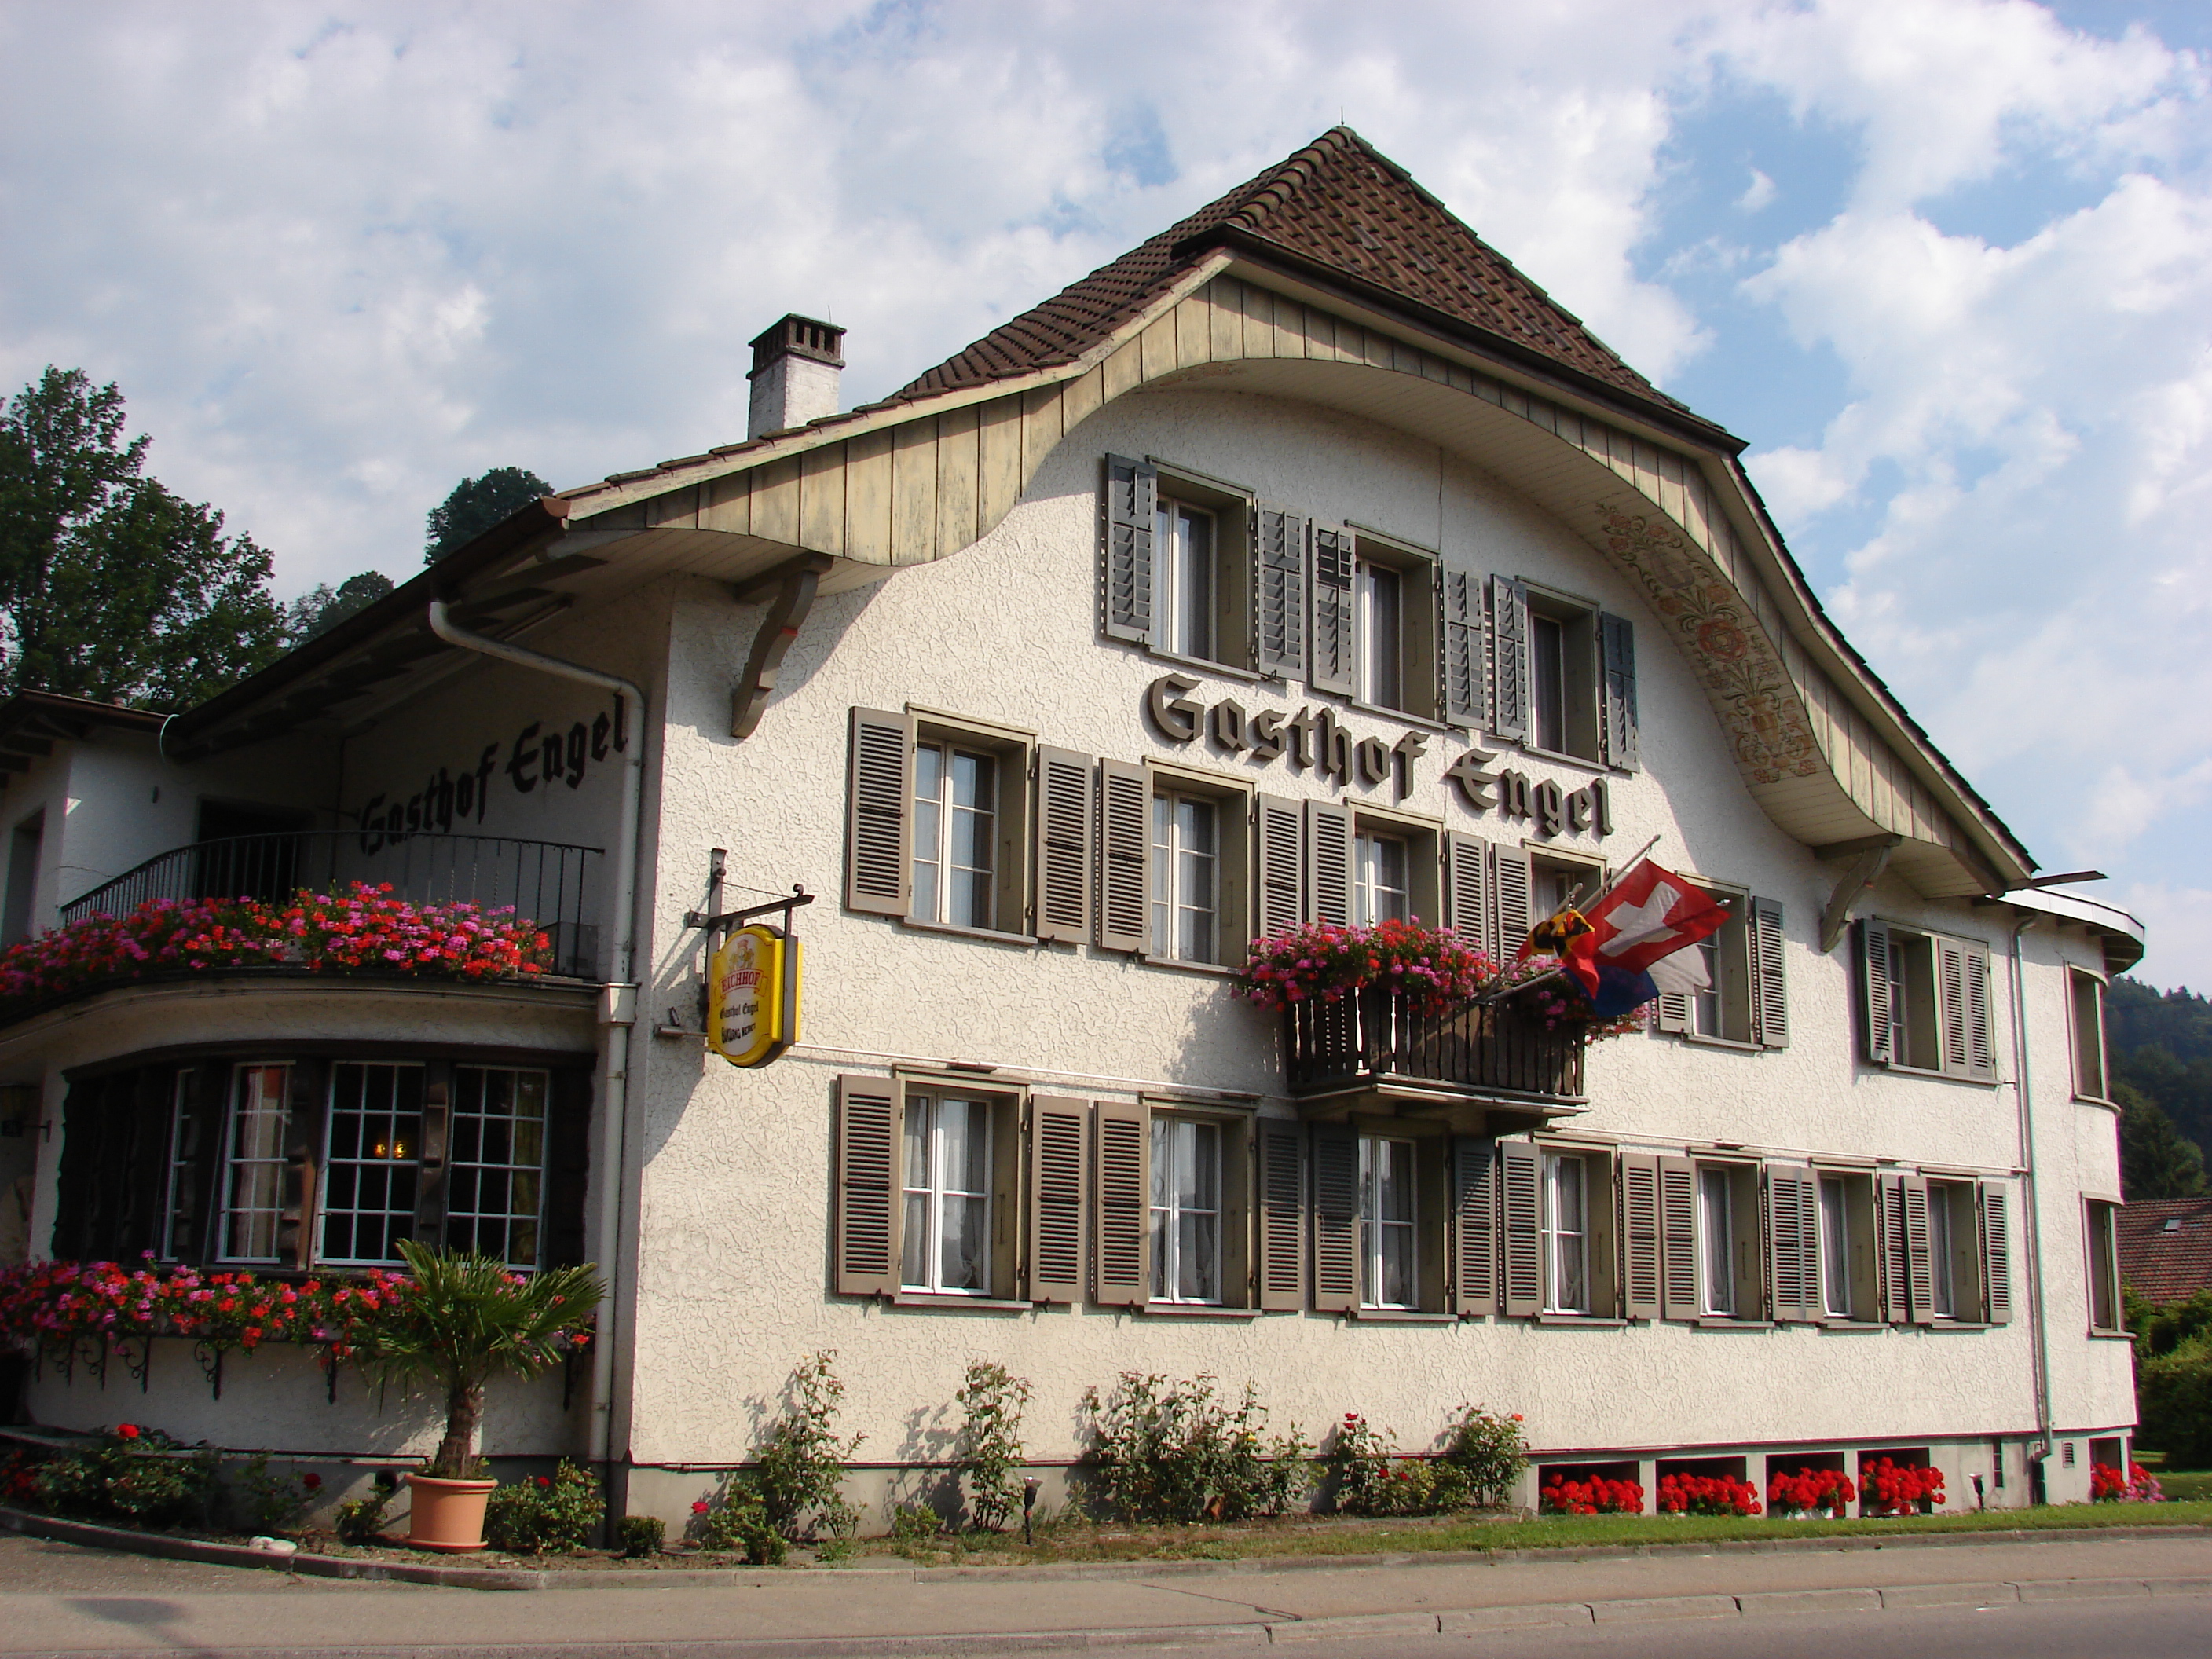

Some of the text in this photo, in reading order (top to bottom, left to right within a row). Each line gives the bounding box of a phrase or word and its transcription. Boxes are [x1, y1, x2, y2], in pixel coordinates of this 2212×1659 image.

[360, 691, 628, 856] Gasthof Engel
[1147, 672, 1614, 837] Gasthof Engel
[721, 971, 761, 993] EICHHOF
